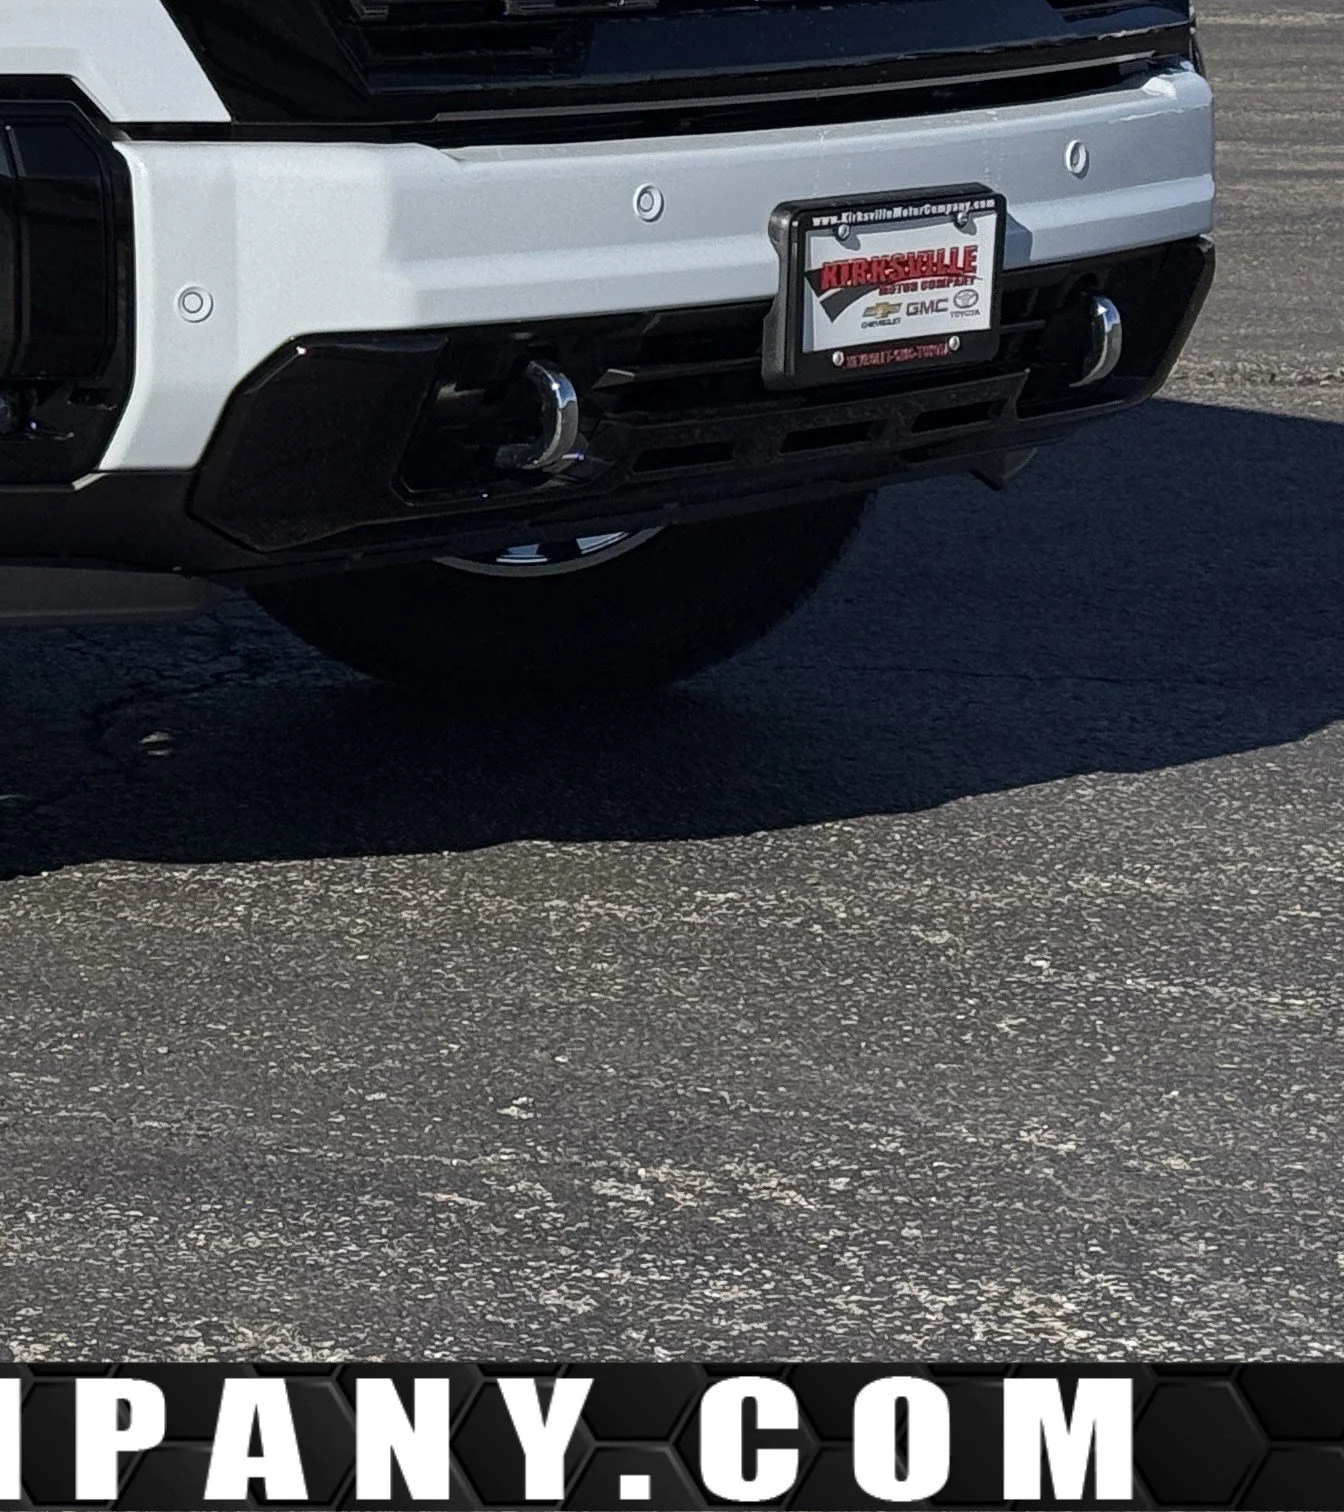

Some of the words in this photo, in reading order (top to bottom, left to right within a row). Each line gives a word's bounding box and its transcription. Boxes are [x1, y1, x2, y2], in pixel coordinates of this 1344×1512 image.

[821, 245, 979, 291] KIRKSVILLE
[878, 280, 919, 296] MOTOR
[920, 276, 976, 292] COMPANY
[905, 298, 950, 316] GMC
